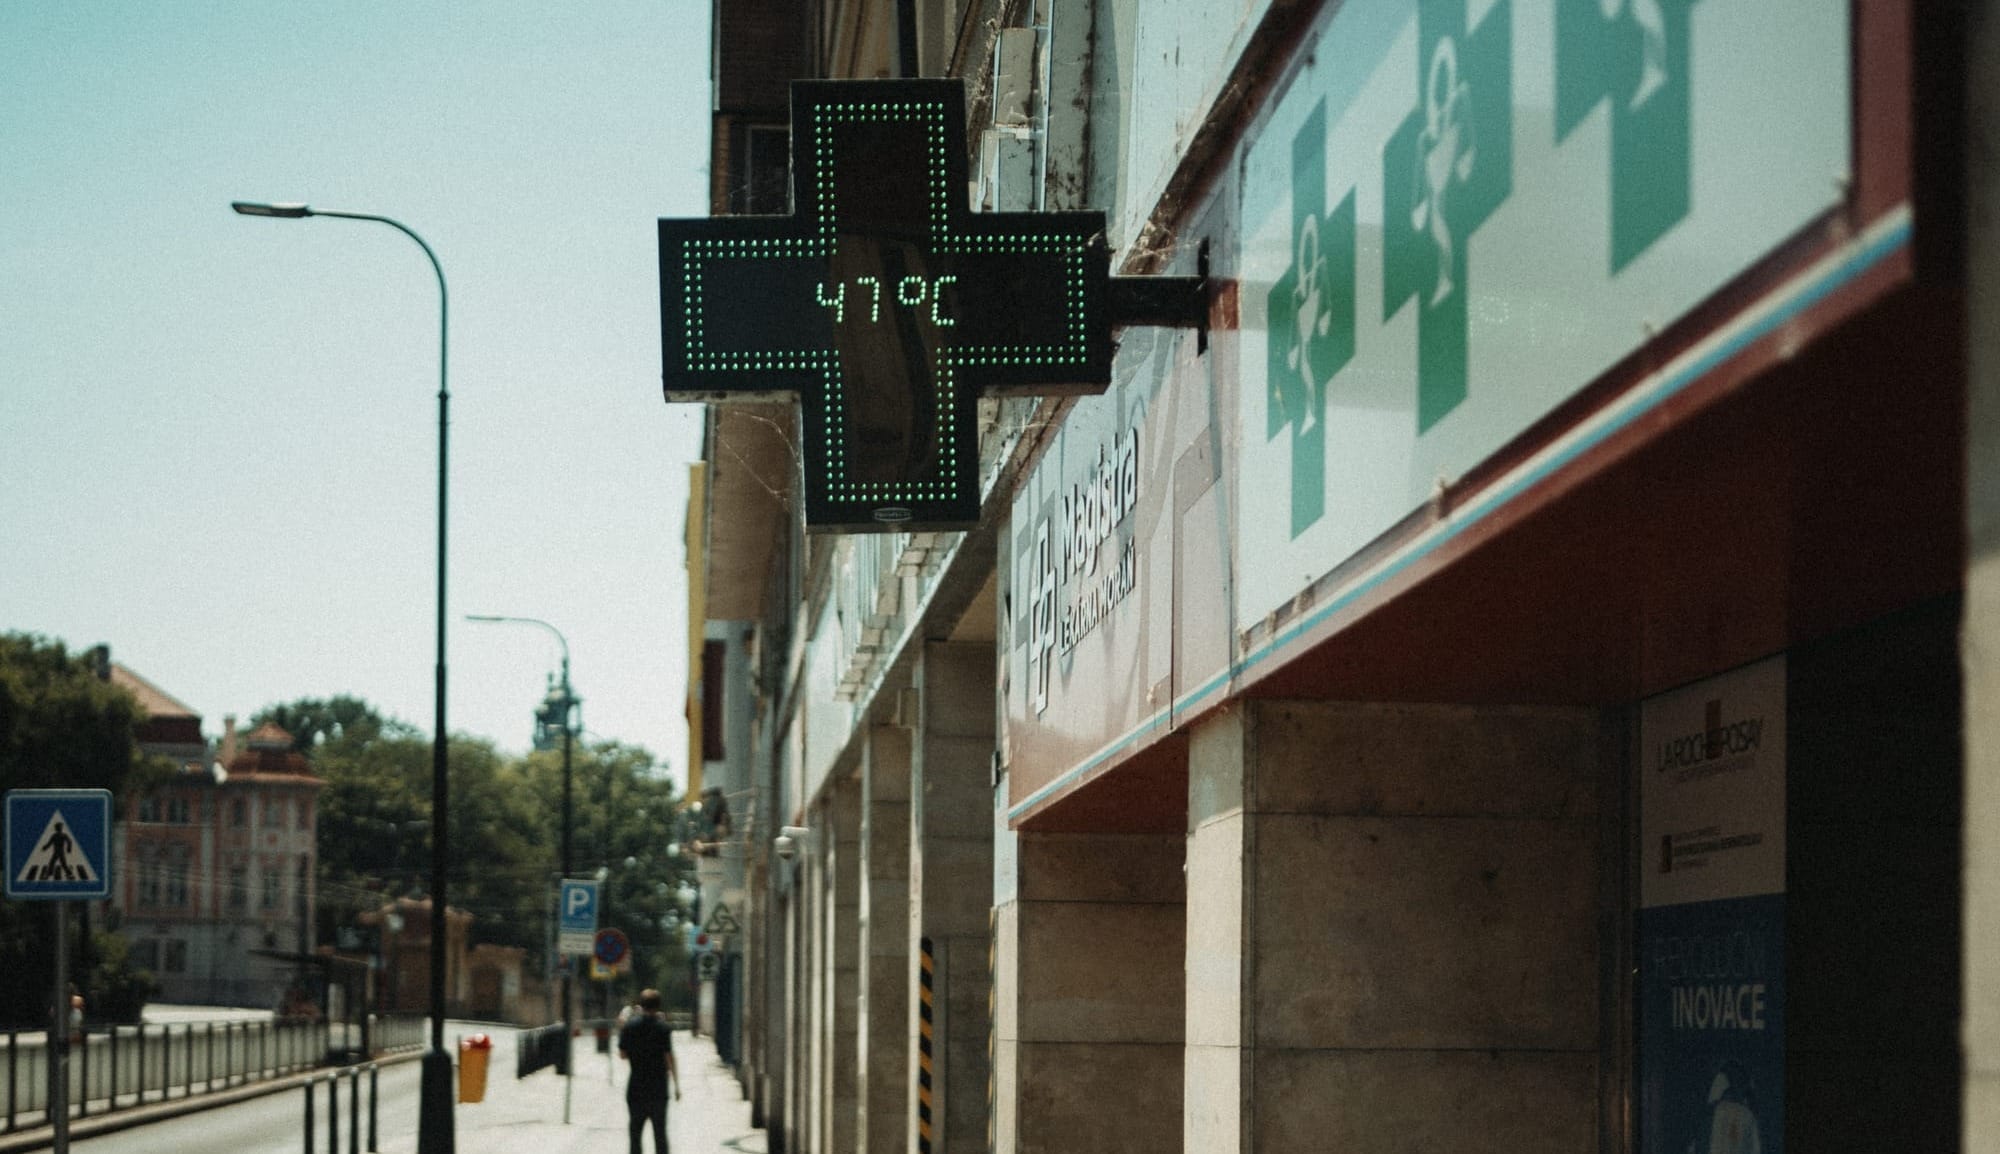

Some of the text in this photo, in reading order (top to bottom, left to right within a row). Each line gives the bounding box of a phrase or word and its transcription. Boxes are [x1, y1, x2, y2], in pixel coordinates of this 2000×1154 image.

[1060, 427, 1138, 586] Magistra
[1060, 588, 1099, 656] LÉKÁRNA
[568, 888, 590, 916] P
[1671, 983, 1765, 1030] INOVACE
